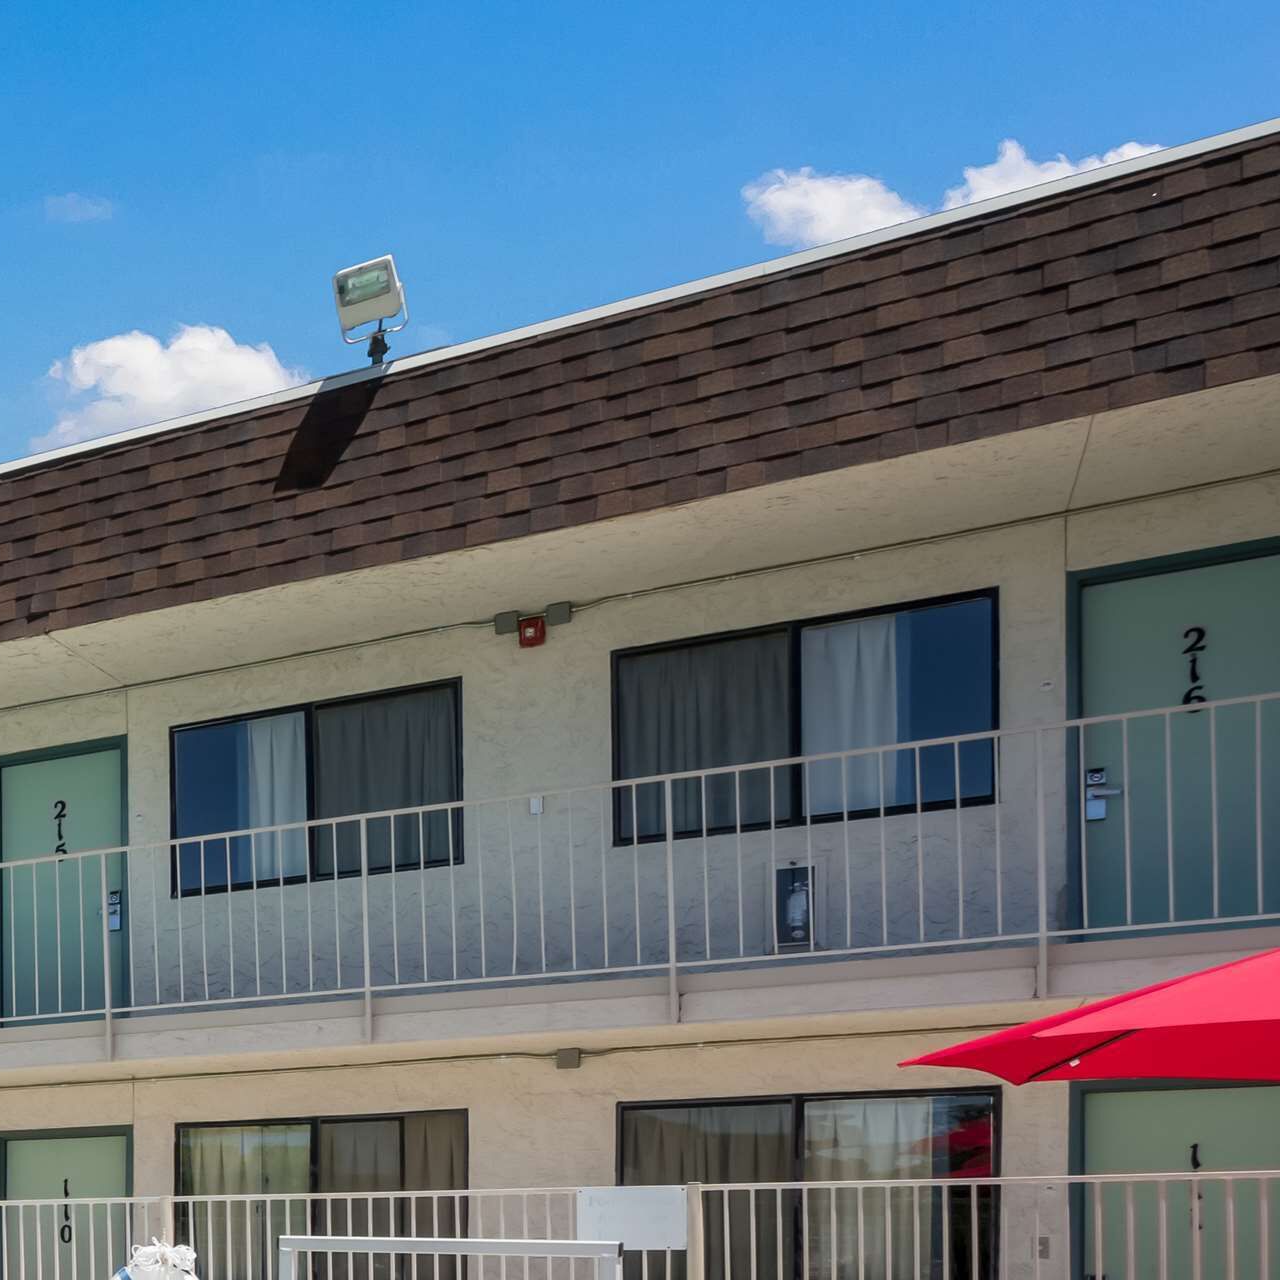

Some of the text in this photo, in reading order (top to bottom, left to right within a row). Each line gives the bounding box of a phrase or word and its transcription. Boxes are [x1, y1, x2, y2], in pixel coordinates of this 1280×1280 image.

[1182, 627, 1207, 713] 216
[54, 800, 68, 862] 215
[60, 1179, 72, 1243] 110
